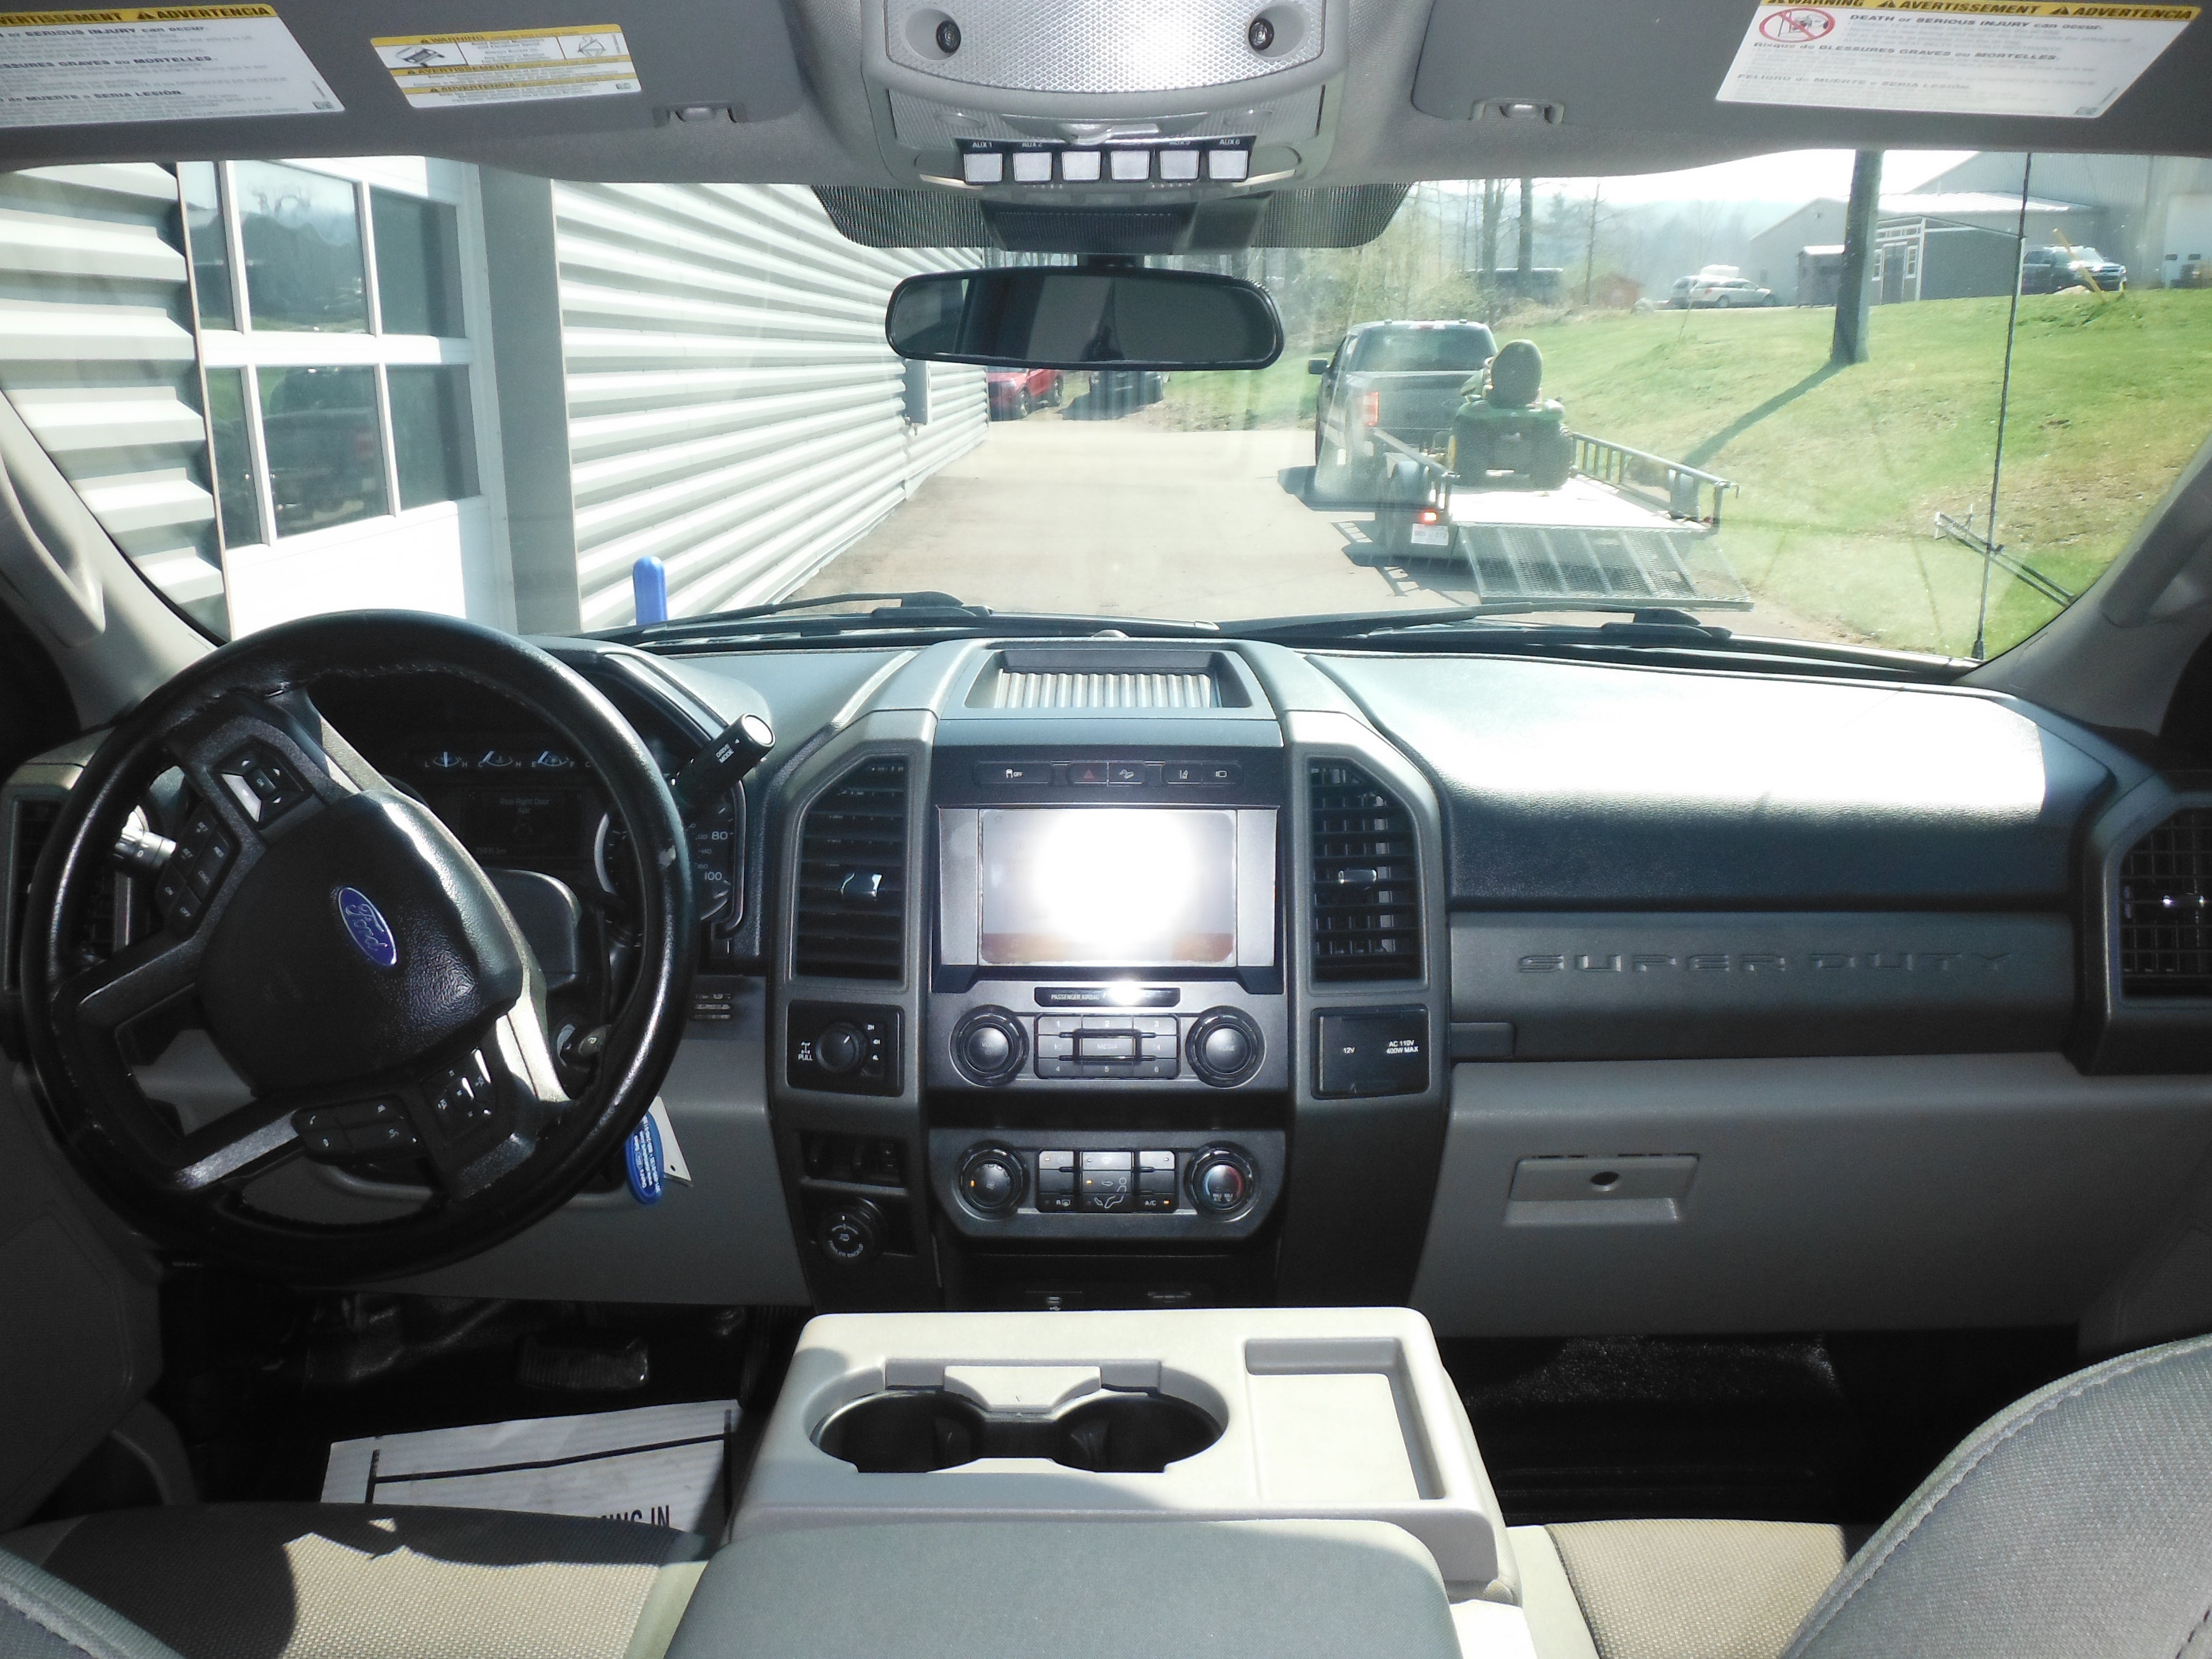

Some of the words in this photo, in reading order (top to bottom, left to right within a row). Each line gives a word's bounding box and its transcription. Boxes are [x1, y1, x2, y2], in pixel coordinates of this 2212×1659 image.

[1899, 1, 2041, 14] AVERTISSEMENT
[2074, 6, 2192, 19] ADVERTENCIA
[716, 742, 730, 758] DRIVE
[719, 747, 735, 763] MODE
[712, 831, 728, 840] 80
[705, 871, 722, 881] 100
[346, 903, 388, 951] Ford
[1519, 954, 1786, 972] SUPER
[1809, 953, 2012, 972] DUTY
[651, 1504, 670, 1527] IN
